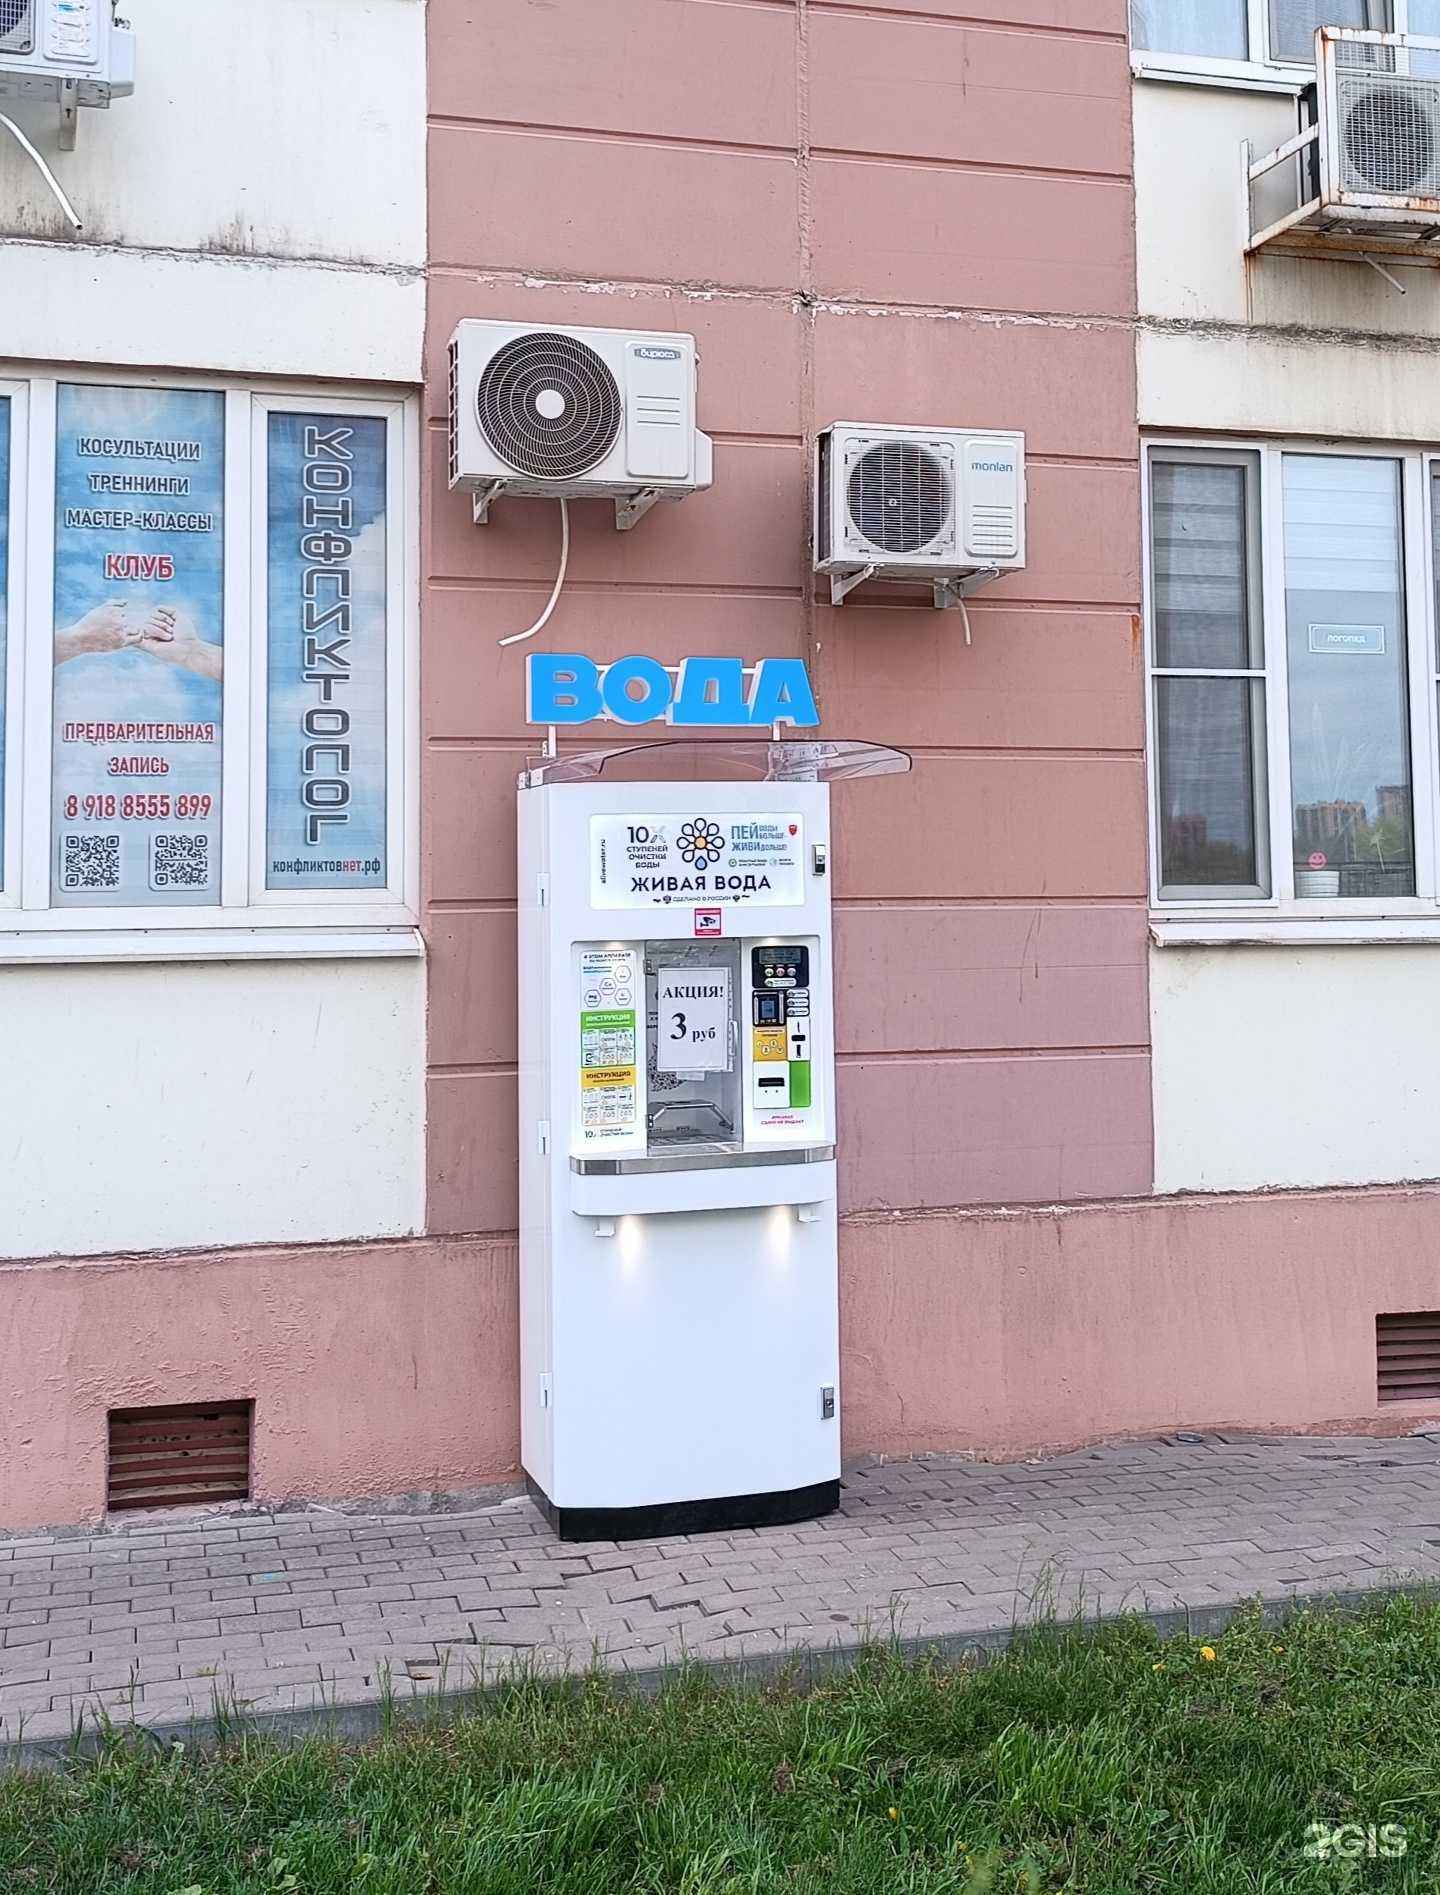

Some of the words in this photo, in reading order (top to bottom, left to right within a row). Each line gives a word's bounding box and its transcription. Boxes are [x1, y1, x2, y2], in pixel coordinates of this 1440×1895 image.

[78, 438, 201, 461] КОСУЛЬТАЦИИ
[971, 462, 1014, 472] monlan
[89, 474, 189, 495] ТРЕННИНГИ
[66, 509, 212, 532] МАСТЕР-КЛАССЫ
[106, 554, 174, 580] КЛУБ
[302, 426, 353, 845] КОНФЛИКТОЛОГ
[526, 653, 821, 727] ВОДА
[64, 723, 214, 744] ПРЕДВАРИТЕЛЬНАЯ
[107, 756, 169, 775] ЗАПИСЬ
[65, 796, 79, 819] 8
[83, 796, 118, 818] 918
[121, 795, 171, 818] 8555
[176, 795, 212, 817] 899
[731, 823, 759, 840] ПЕЙ
[626, 844, 668, 853] СТУПЕНЕЙ
[732, 841, 760, 852] ЖИВИ
[273, 858, 381, 877] конфликтовнет.рф
[628, 853, 667, 862] ОЧИСТКИ
[631, 876, 707, 893] ЖИВАЯ
[715, 874, 772, 892] ВОДА
[662, 986, 724, 999] АКЦИЯ!
[670, 1012, 687, 1040] 3
[692, 1027, 716, 1042] руб
